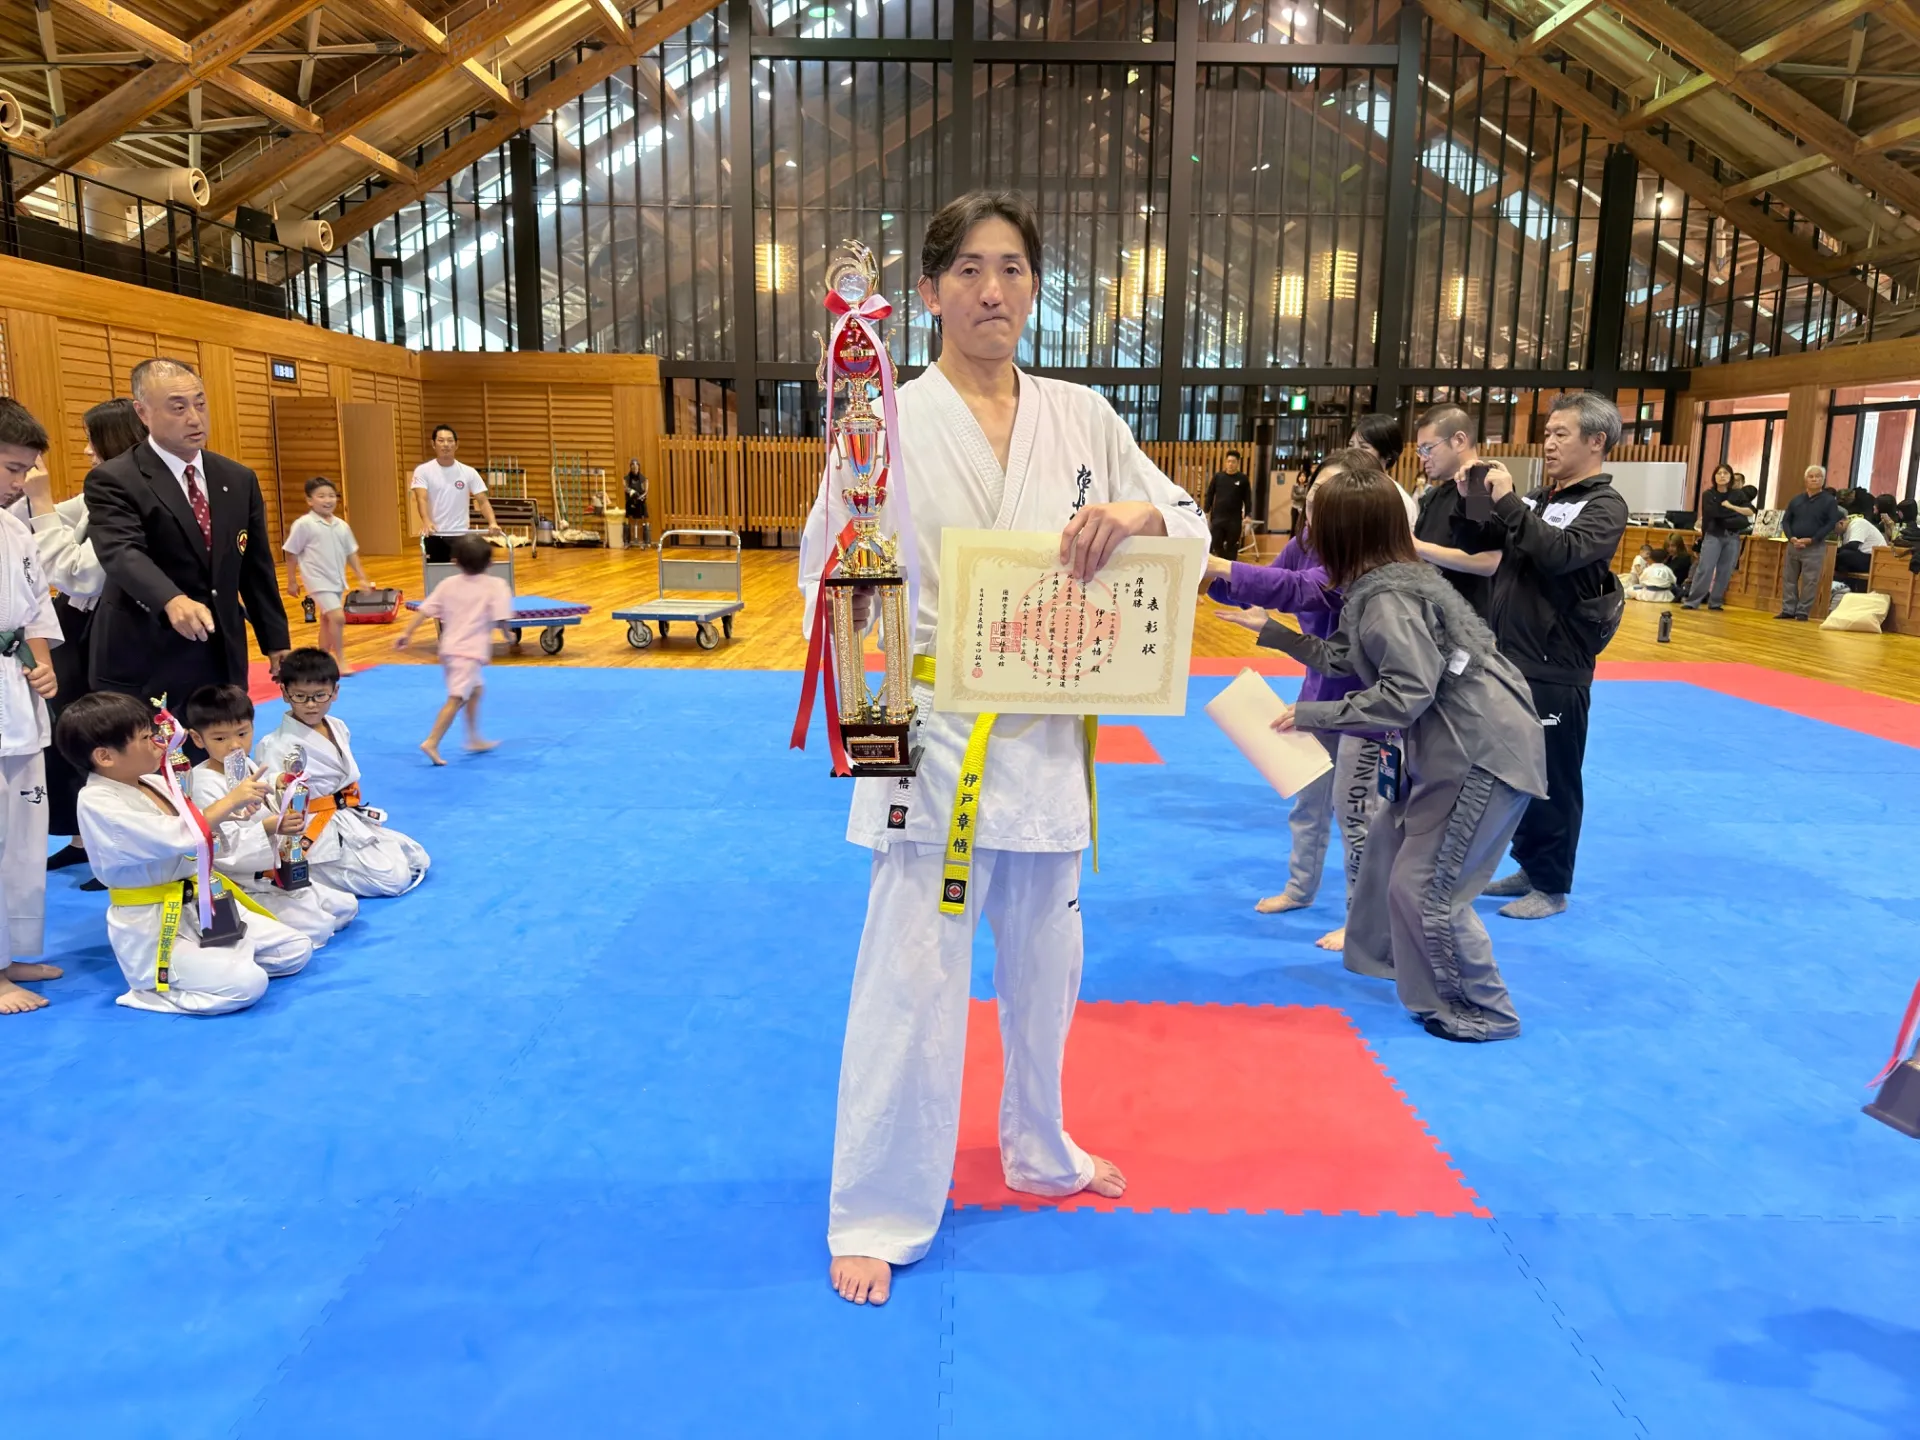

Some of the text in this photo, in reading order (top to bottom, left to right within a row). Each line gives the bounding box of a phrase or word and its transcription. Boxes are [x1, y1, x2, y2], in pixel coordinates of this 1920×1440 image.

[1132, 576, 1145, 609] 準優勝
[1141, 596, 1159, 656] 表彰状
[952, 772, 979, 854] 伊戸章悟
